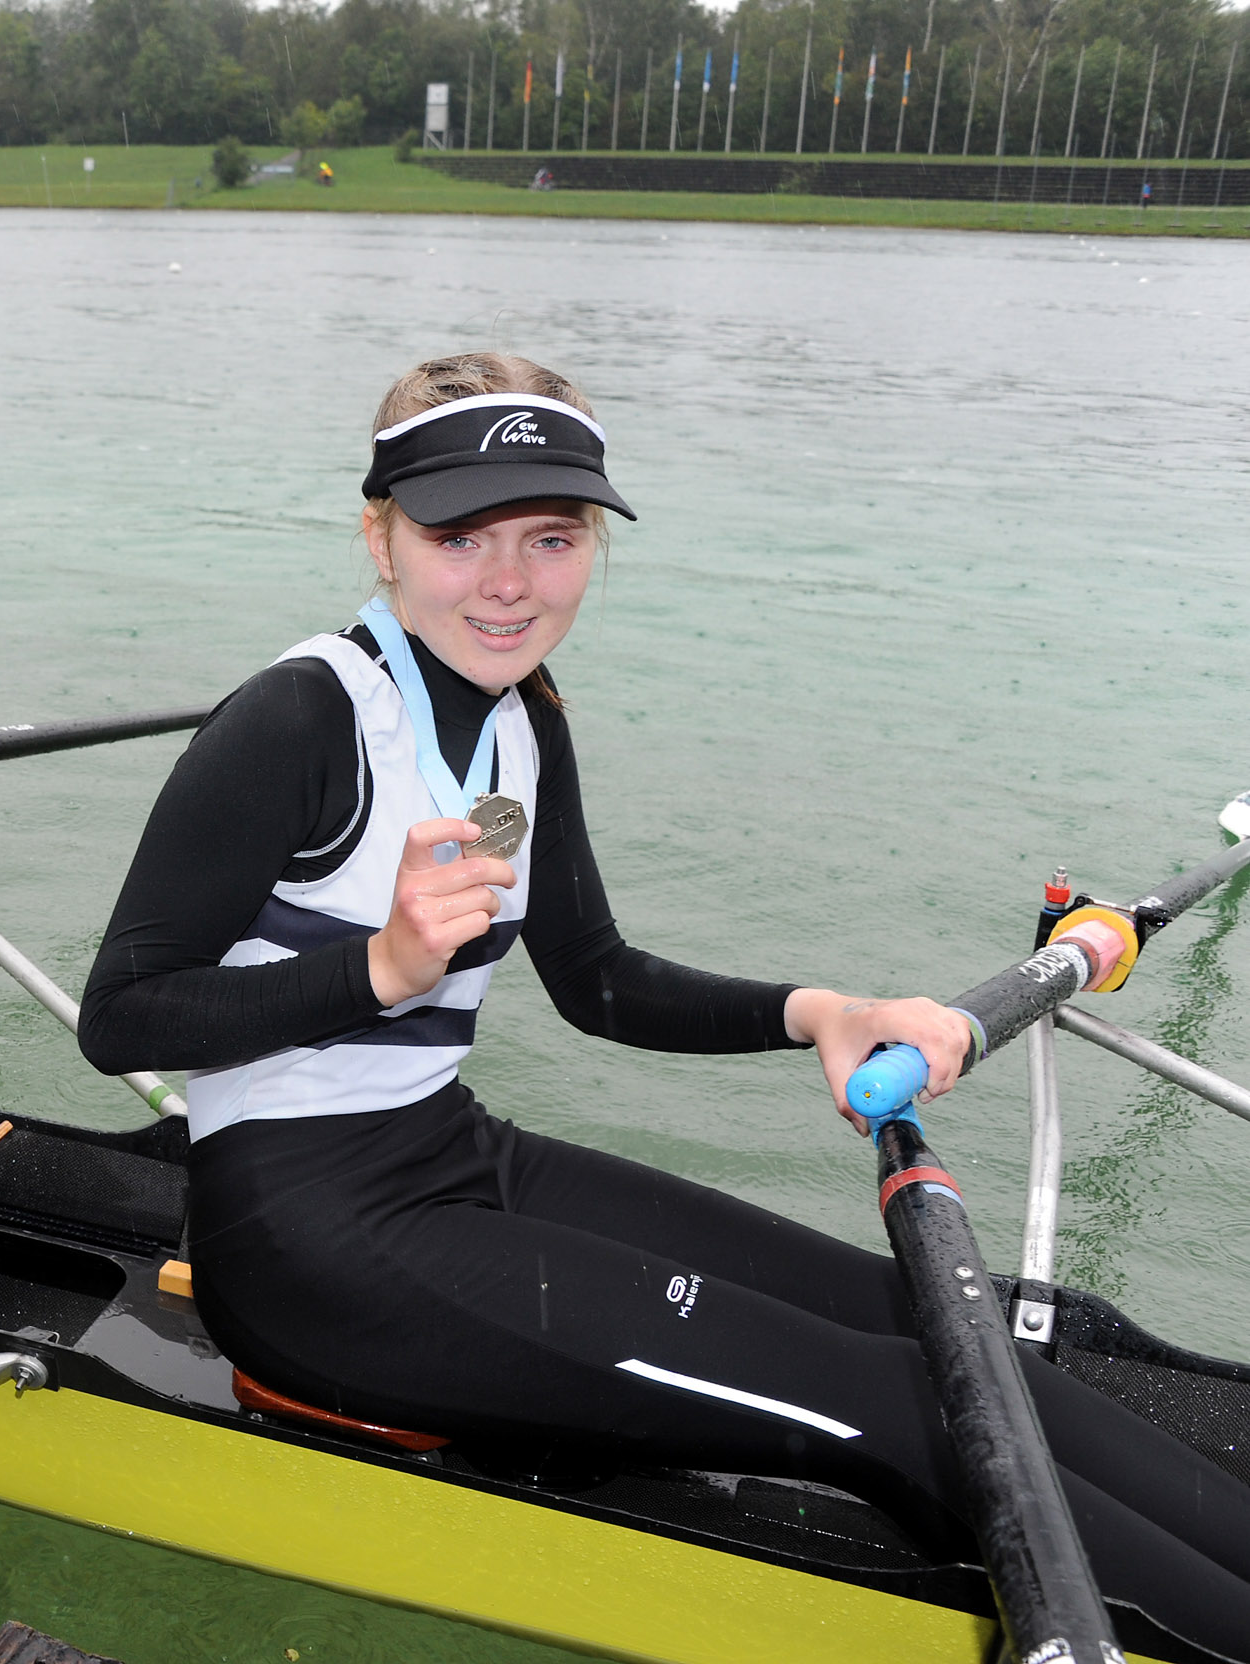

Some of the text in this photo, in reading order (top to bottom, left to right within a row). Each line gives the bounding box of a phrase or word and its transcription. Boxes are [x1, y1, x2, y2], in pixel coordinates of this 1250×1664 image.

[479, 411, 539, 452] New
[501, 431, 547, 445] Wave
[678, 1274, 703, 1318] Kalenji
